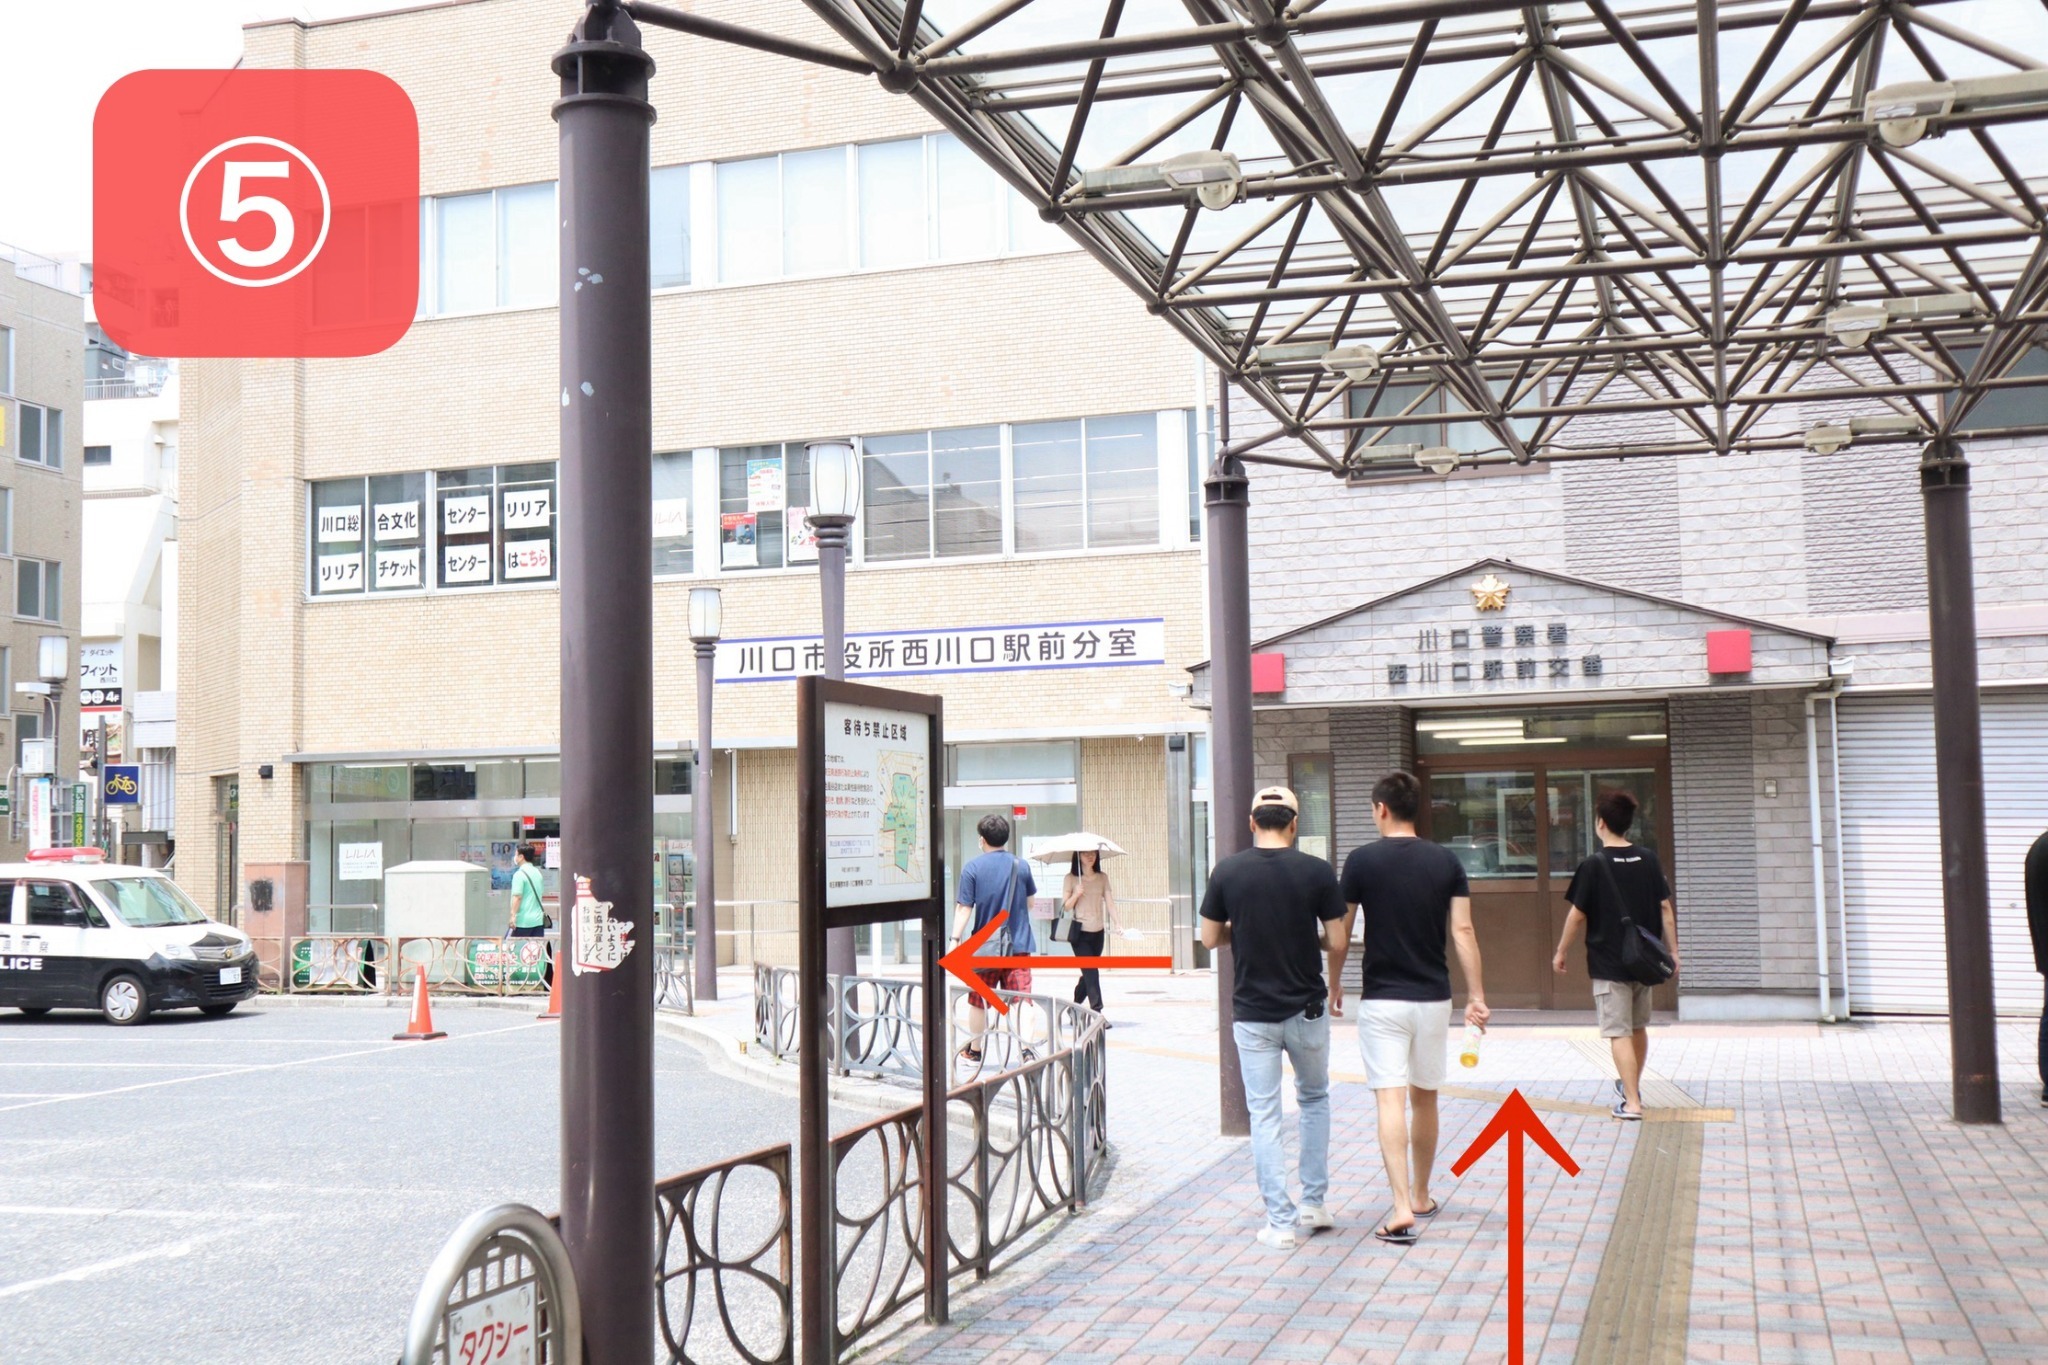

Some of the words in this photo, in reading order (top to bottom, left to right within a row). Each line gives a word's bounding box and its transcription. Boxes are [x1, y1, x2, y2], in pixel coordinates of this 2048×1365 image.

[321, 514, 360, 533] 川口総
[377, 511, 417, 530] 合文化
[447, 506, 487, 524] センター
[507, 500, 547, 517] リリア
[321, 563, 360, 581] リリア
[378, 558, 417, 577] チケット
[448, 554, 487, 572] センター
[508, 550, 548, 569] はこちら
[1418, 622, 1568, 650] 川口警察署
[1387, 654, 1602, 685] 西川口駅前交番
[105, 691, 120, 703] 4F
[844, 718, 907, 741] 客待ち禁止区域
[458, 1321, 529, 1365] タクシー
